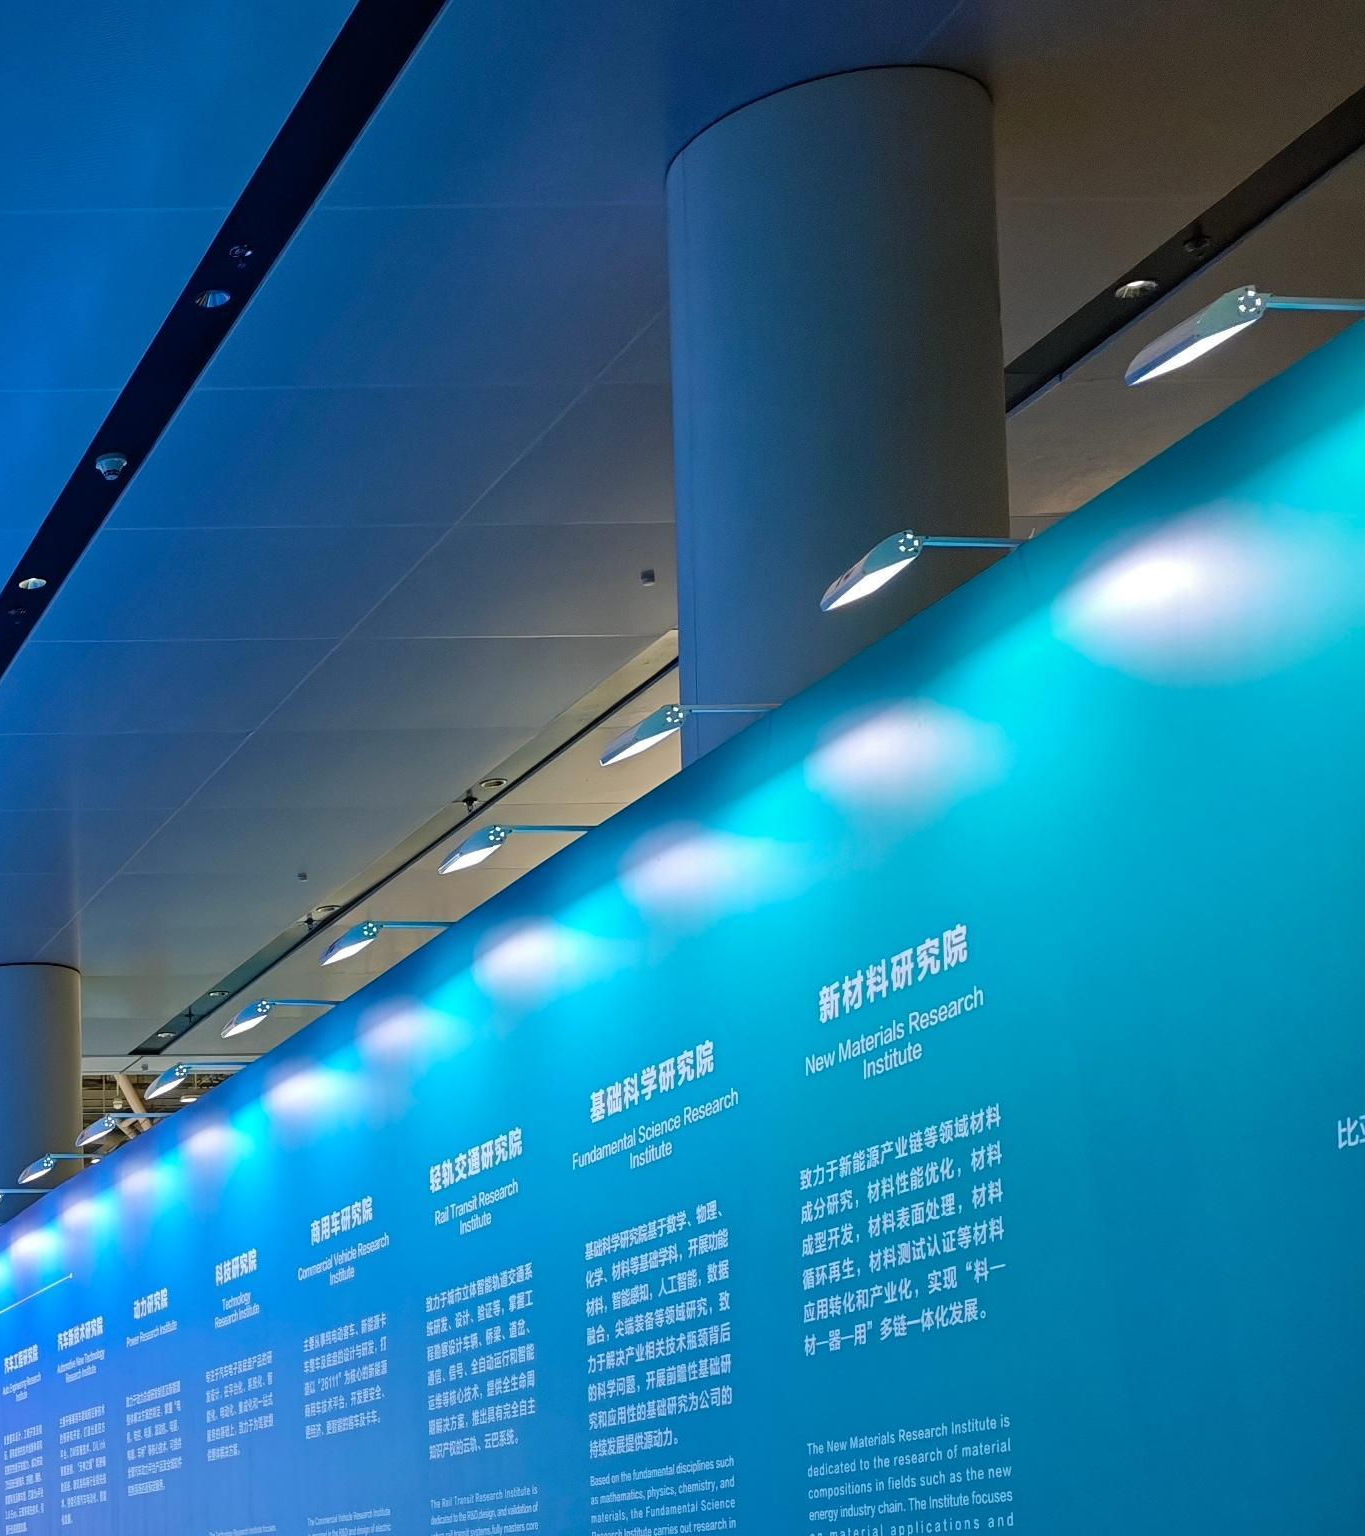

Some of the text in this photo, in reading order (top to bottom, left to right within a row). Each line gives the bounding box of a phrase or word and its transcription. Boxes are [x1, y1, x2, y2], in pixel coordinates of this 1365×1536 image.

[819, 924, 968, 1023] 新材料研究院
[805, 986, 984, 1076] New Materials Research
[863, 1041, 923, 1080] Institute
[590, 1040, 714, 1123] 基础科学研究院
[573, 1088, 739, 1170] Fundamental Science Research
[800, 1104, 1001, 1191] 致力于新能源产业链等领域材料
[630, 1140, 672, 1169] Institute
[311, 1196, 373, 1246] 商用车研究院
[435, 1178, 518, 1226] Rail Transit Research
[460, 1211, 491, 1235] Institute
[215, 1248, 257, 1286] 科技研究院
[298, 1232, 389, 1280] Commercial Vehicle Research
[330, 1265, 355, 1286] Institute
[807, 1414, 1009, 1454] The New Materials Research Institute is
[807, 1437, 1010, 1477] dedicated to the research of material
[808, 1466, 1011, 1499] compositions in fields such as the new
[630, 1508, 643, 1519] the
[645, 1500, 697, 1517] Fundamental
[701, 1498, 734, 1511] Science
[809, 1490, 1012, 1521] energy industry chain. The Institute focuses
[891, 1517, 979, 1536] applications
[988, 1512, 1013, 1528] and
